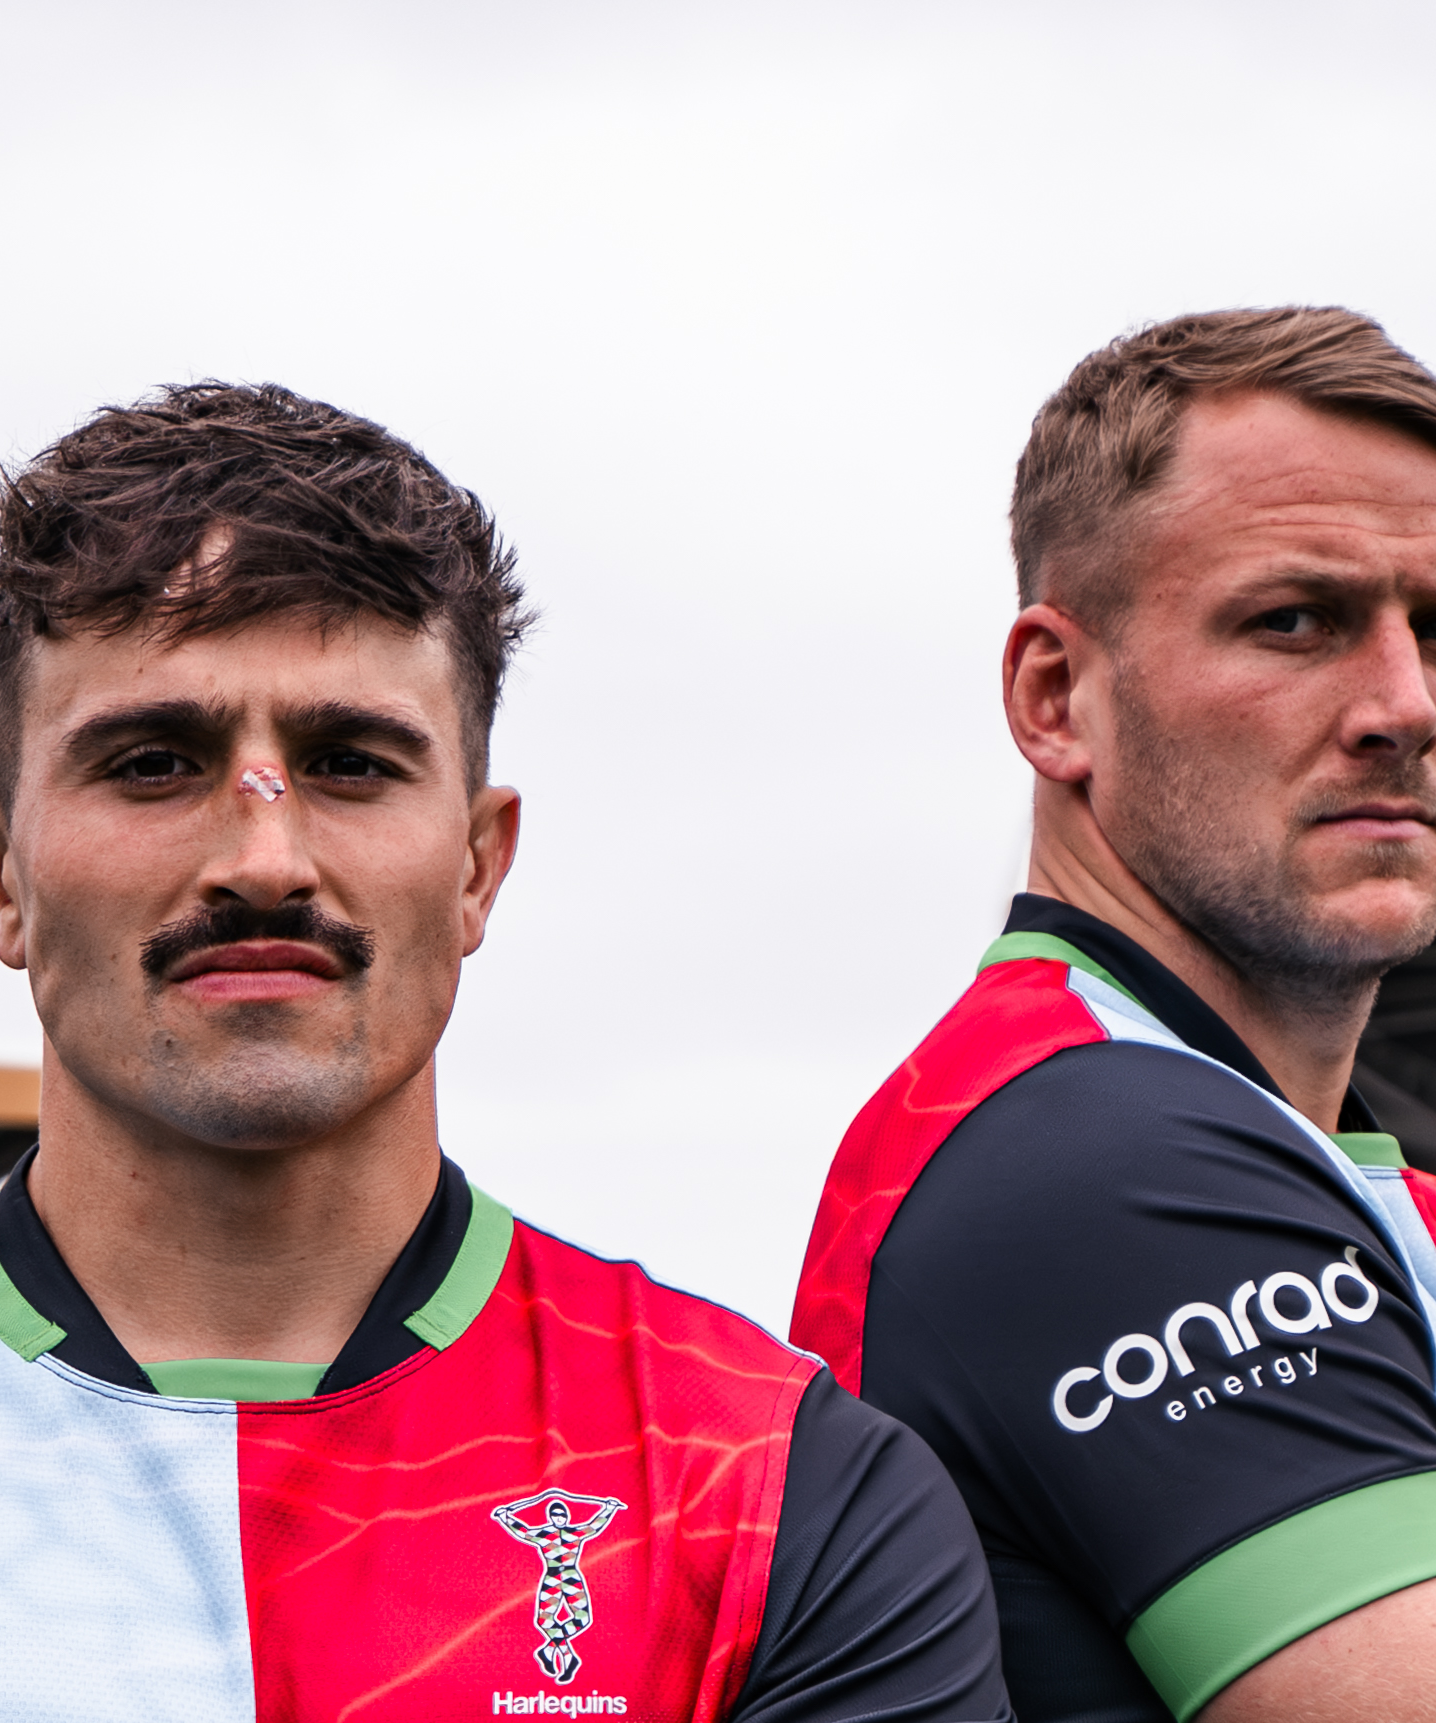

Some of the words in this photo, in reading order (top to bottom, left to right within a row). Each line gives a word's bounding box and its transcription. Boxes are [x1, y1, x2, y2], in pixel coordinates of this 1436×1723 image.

[1053, 1245, 1379, 1433] conrad
[1166, 1347, 1317, 1421] energy
[492, 1690, 628, 1719] Harlequins
